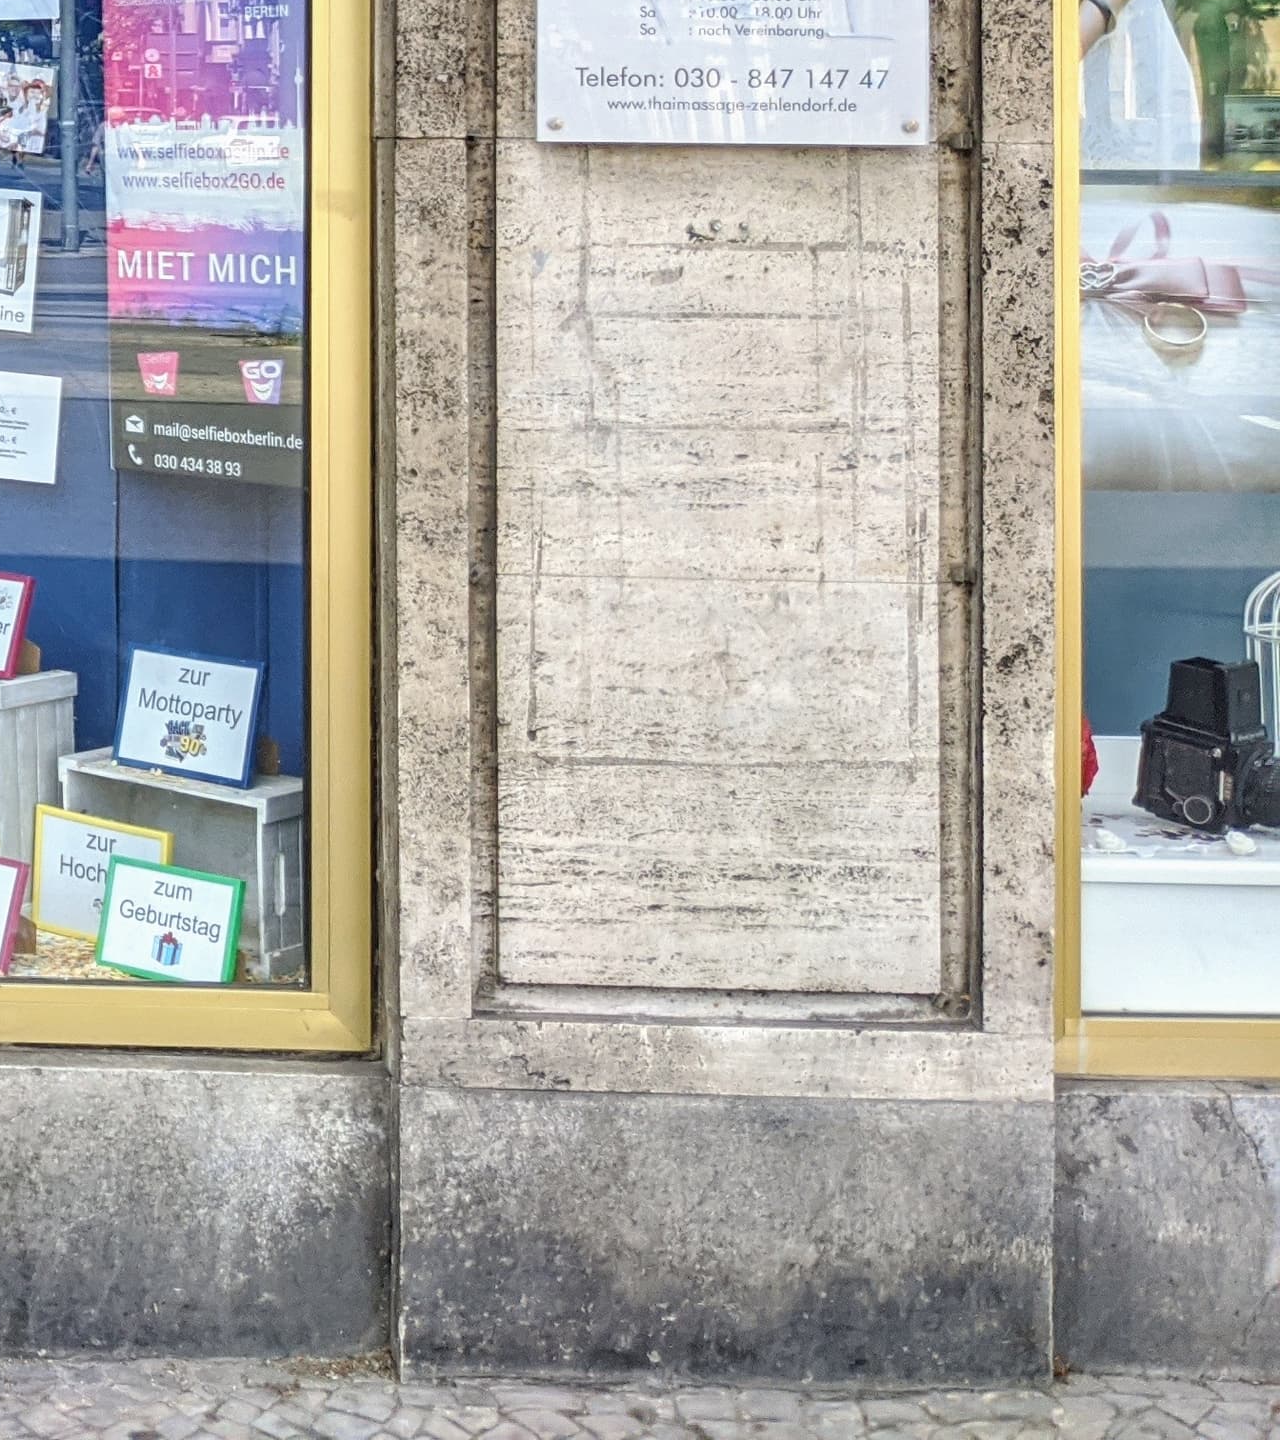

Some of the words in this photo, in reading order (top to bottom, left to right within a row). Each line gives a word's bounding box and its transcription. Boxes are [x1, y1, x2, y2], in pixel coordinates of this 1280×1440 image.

[245, 5, 288, 18] BERLIN
[640, 6, 656, 18] Sa
[797, 6, 822, 19] Uhr
[640, 24, 656, 36] So
[698, 23, 731, 36] nach
[735, 23, 825, 39] Vereinbarung
[575, 66, 665, 88] Telefon:
[674, 68, 721, 88] 030
[748, 68, 794, 89] 847
[805, 68, 849, 89] 147
[858, 68, 889, 89] 47
[607, 96, 857, 113] www.thaimassage-zehlendorf.de
[122, 172, 285, 190] www.selfiebox2GO.de
[117, 250, 195, 281] MIET
[208, 253, 297, 286] MICH
[242, 361, 282, 379] GO
[153, 422, 303, 450] mail@selfieboxberlin.de
[154, 454, 177, 470] 030
[180, 456, 204, 472] 434
[206, 459, 222, 475] 38
[225, 461, 241, 477] 93
[178, 668, 211, 686] zur
[138, 688, 243, 730] Mottoparty
[86, 833, 117, 853] zur
[60, 854, 108, 884] Hoch
[153, 880, 193, 902] zum
[120, 899, 221, 943] Geburtstag
